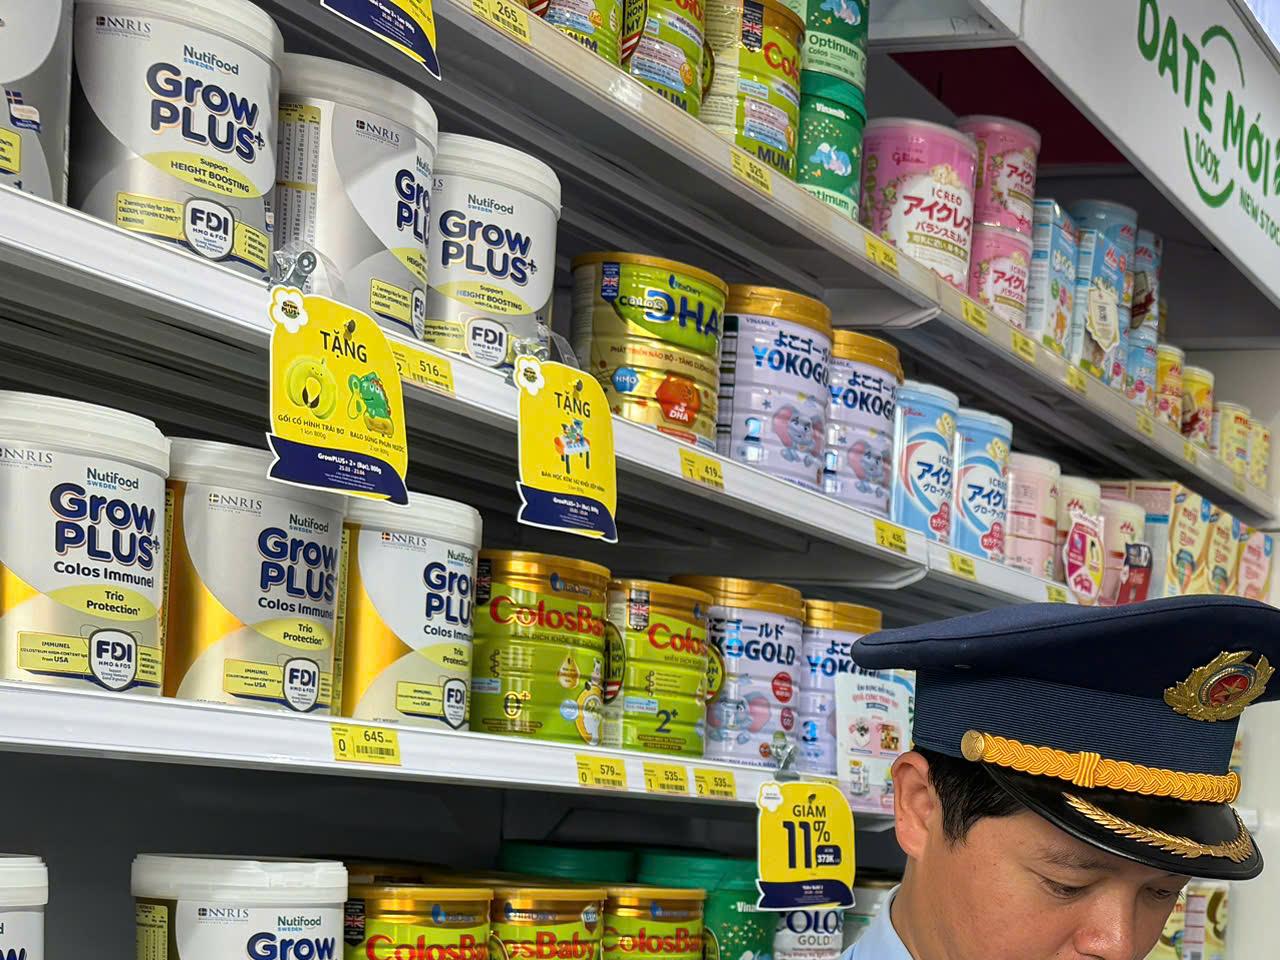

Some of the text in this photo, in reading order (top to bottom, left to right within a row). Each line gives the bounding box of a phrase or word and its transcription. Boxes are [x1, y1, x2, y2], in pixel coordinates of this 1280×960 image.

[498, 1, 518, 23] 265
[808, 34, 859, 62] Optimum
[184, 45, 239, 75] Nutifood
[184, 57, 215, 72] SWEDEN
[146, 62, 259, 128] Grow
[200, 157, 229, 173] Support
[170, 160, 250, 194] HEIGHT BOOSTING
[468, 194, 514, 215] Nutifood
[1239, 187, 1258, 223] NEW
[191, 207, 230, 236] FDI
[439, 210, 531, 255] Grow
[456, 289, 522, 311] HEIGHT BOOSTING
[480, 285, 504, 295] Support
[644, 289, 721, 336] DHA
[319, 328, 369, 364] TẶNG
[471, 326, 504, 347] FDI
[419, 360, 440, 377] 516
[554, 391, 591, 419] TẶNG
[669, 410, 689, 422] DHA
[86, 466, 139, 491] Nutifood
[704, 465, 719, 480] 419
[86, 479, 117, 491] SWEDEN
[49, 482, 156, 536] Grow
[289, 513, 329, 534] Nutifood
[258, 527, 338, 571] Grow
[53, 561, 155, 588] Colos Immunel
[104, 590, 125, 602] Trio
[258, 596, 295, 613] Colos
[489, 595, 605, 637] ColosBa
[298, 624, 313, 634] Trio
[424, 624, 452, 638] Colos
[41, 640, 71, 649] IMMUNEL
[95, 639, 133, 662] FDI
[453, 647, 464, 657] Trio
[54, 655, 69, 665] USA
[289, 667, 316, 686] FDI
[447, 687, 465, 703] FDI
[338, 731, 384, 752] 0 645
[600, 763, 616, 775] 579
[664, 770, 679, 781] 535
[713, 776, 728, 788] 535
[277, 914, 322, 928] Nutifood
